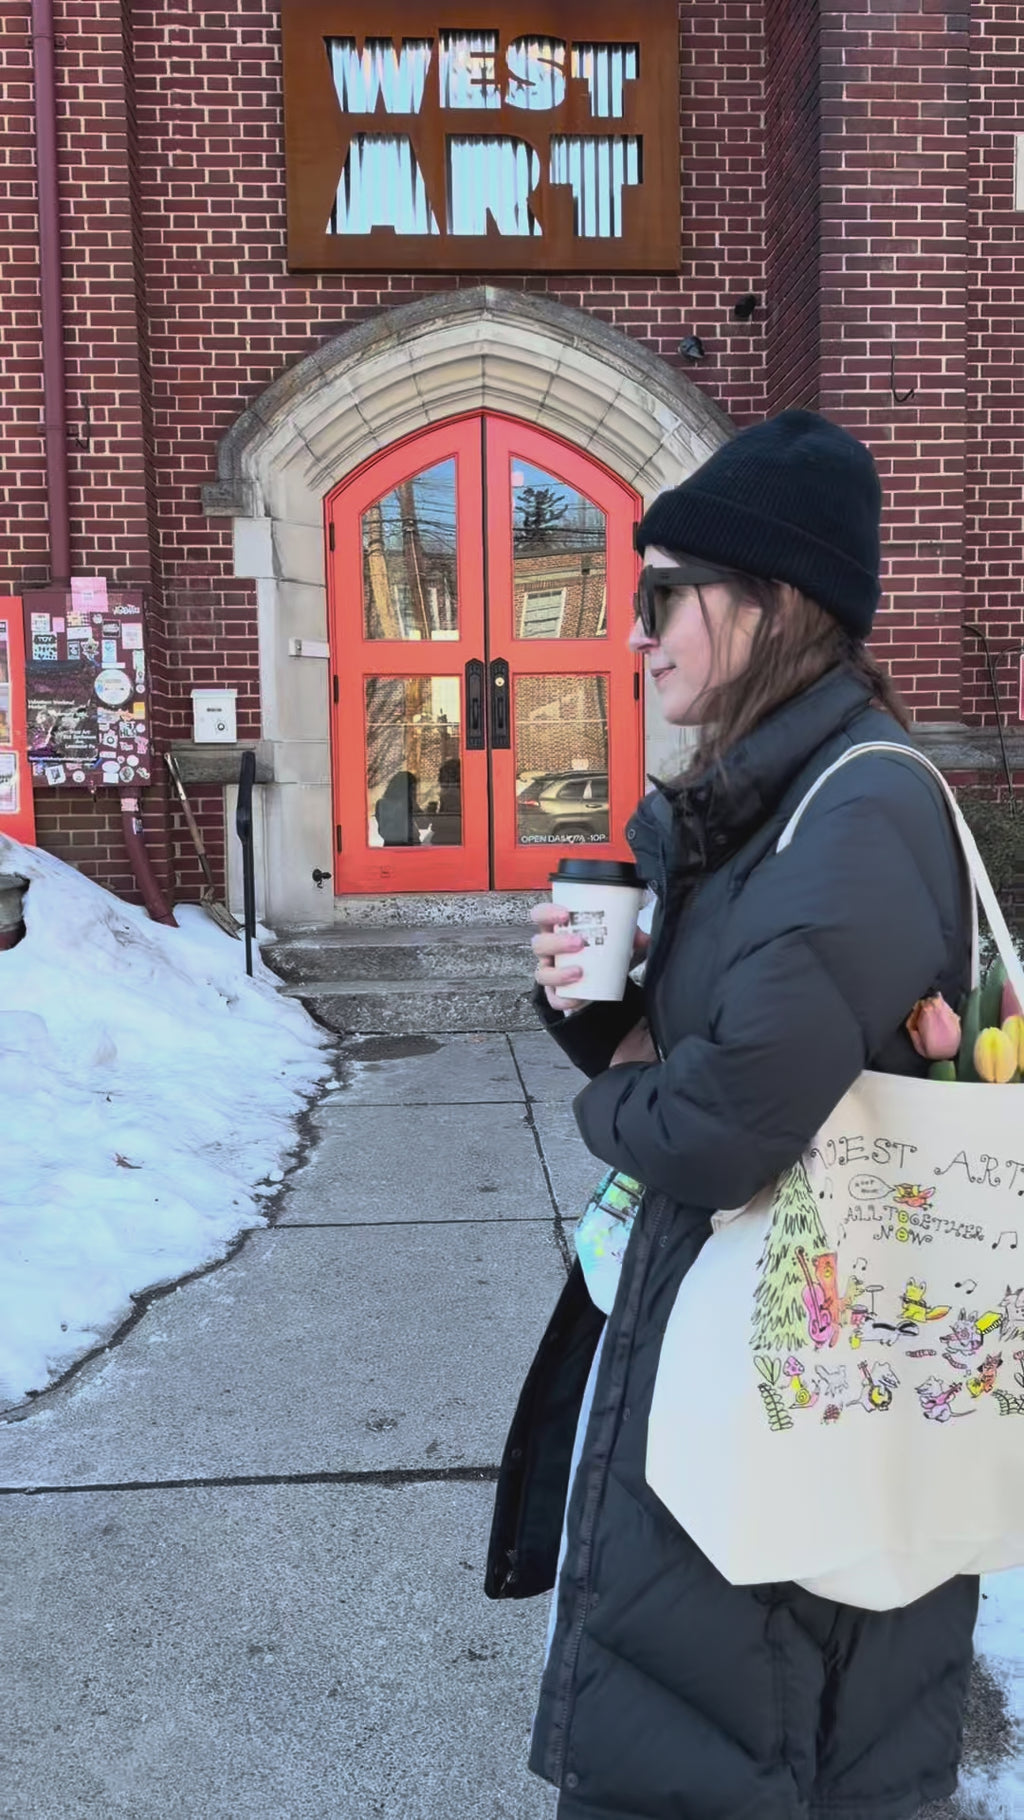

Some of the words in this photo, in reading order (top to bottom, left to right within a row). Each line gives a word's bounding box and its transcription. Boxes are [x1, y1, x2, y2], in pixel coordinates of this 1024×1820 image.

[322, 28, 640, 117] WEST
[325, 132, 643, 237] ART
[521, 834, 546, 843] OPEN
[933, 1150, 1024, 1189] ART
[873, 1224, 933, 1246] NOW
